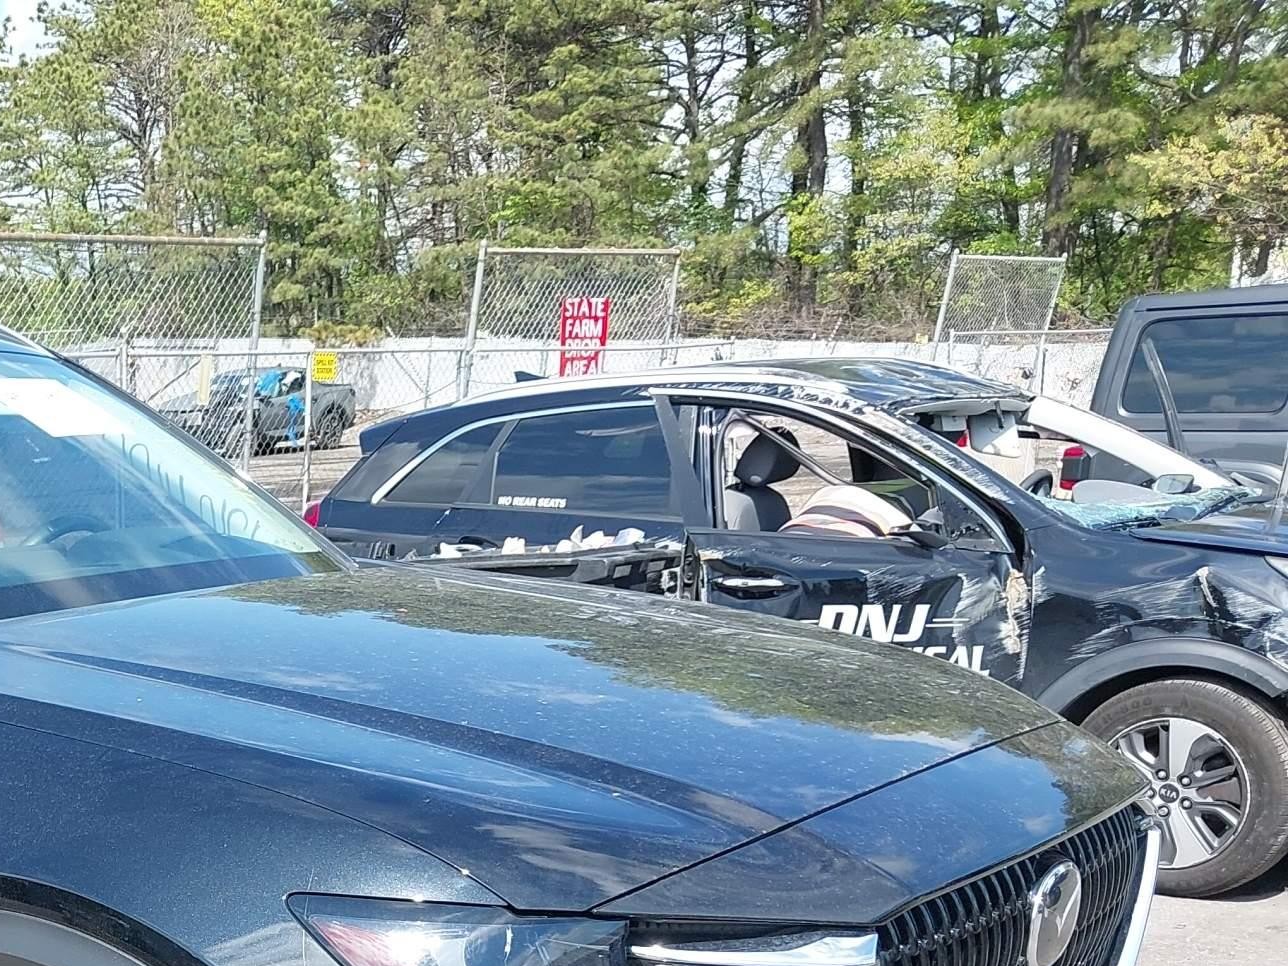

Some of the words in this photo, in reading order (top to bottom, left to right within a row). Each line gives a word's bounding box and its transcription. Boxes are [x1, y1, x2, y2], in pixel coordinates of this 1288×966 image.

[564, 297, 606, 317] STATE
[564, 318, 603, 338] FARM
[497, 496, 513, 506] NO
[512, 496, 538, 507] REAR
[537, 497, 568, 508] SEATS
[1159, 787, 1178, 799] KIA
